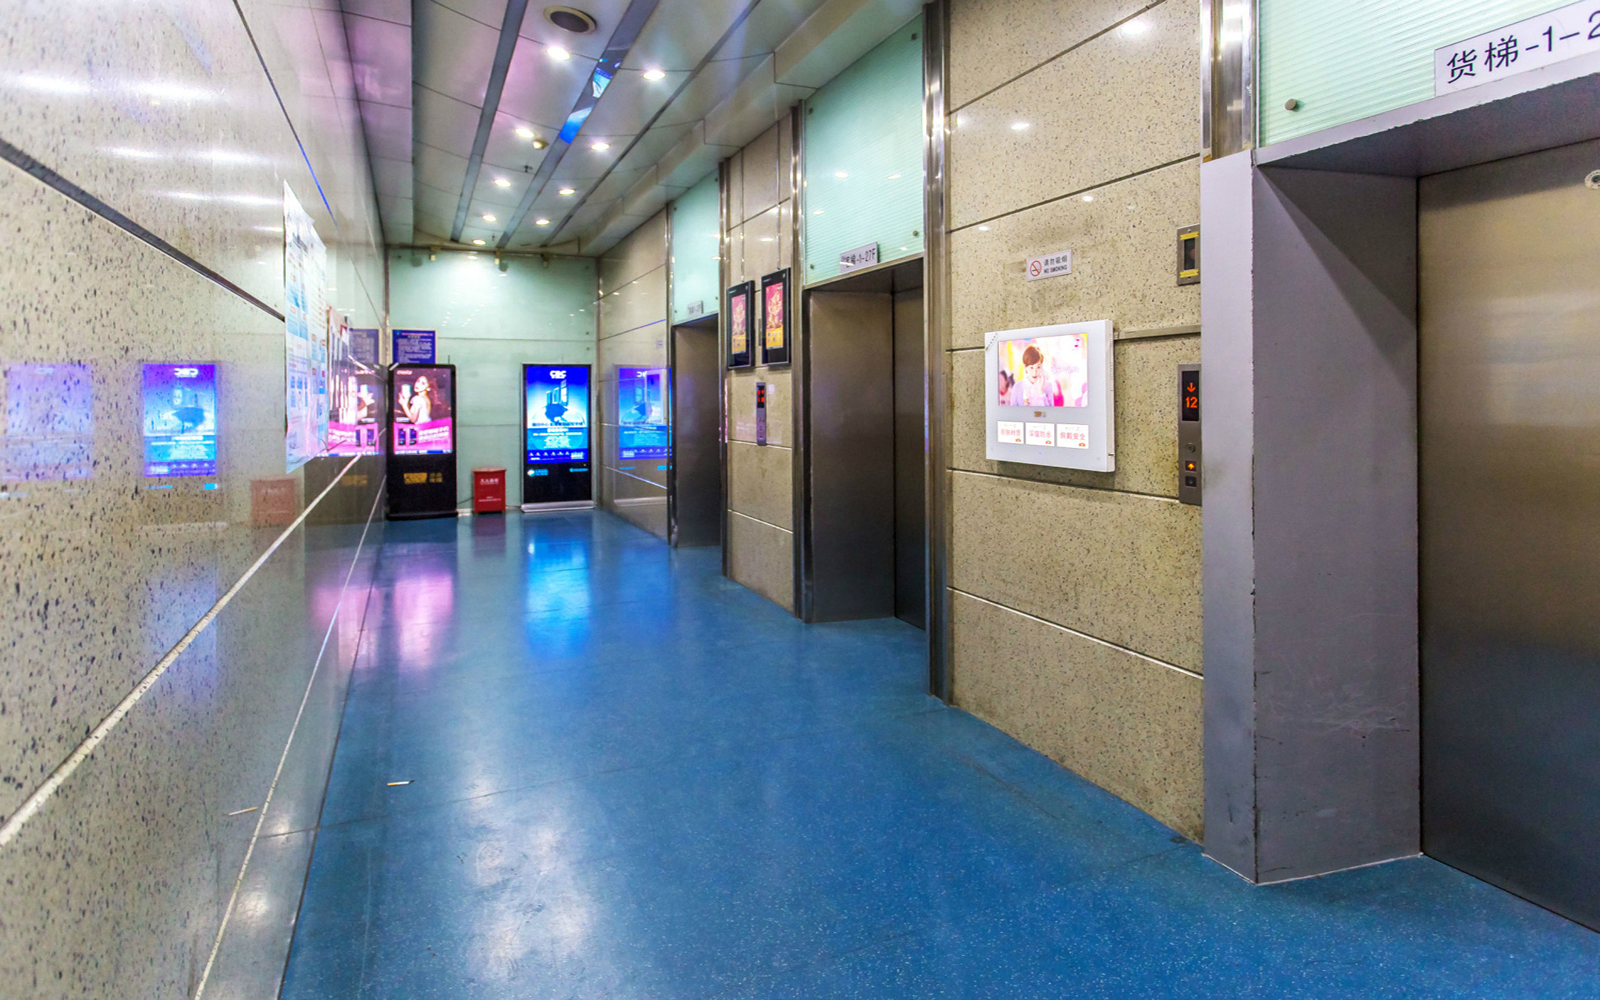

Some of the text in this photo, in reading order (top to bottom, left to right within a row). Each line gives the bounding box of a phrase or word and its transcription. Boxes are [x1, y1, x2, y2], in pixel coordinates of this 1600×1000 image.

[1447, 10, 1600, 84] 货梯-1-2
[1050, 264, 1068, 272] SMOKING
[1185, 396, 1198, 409] 12
